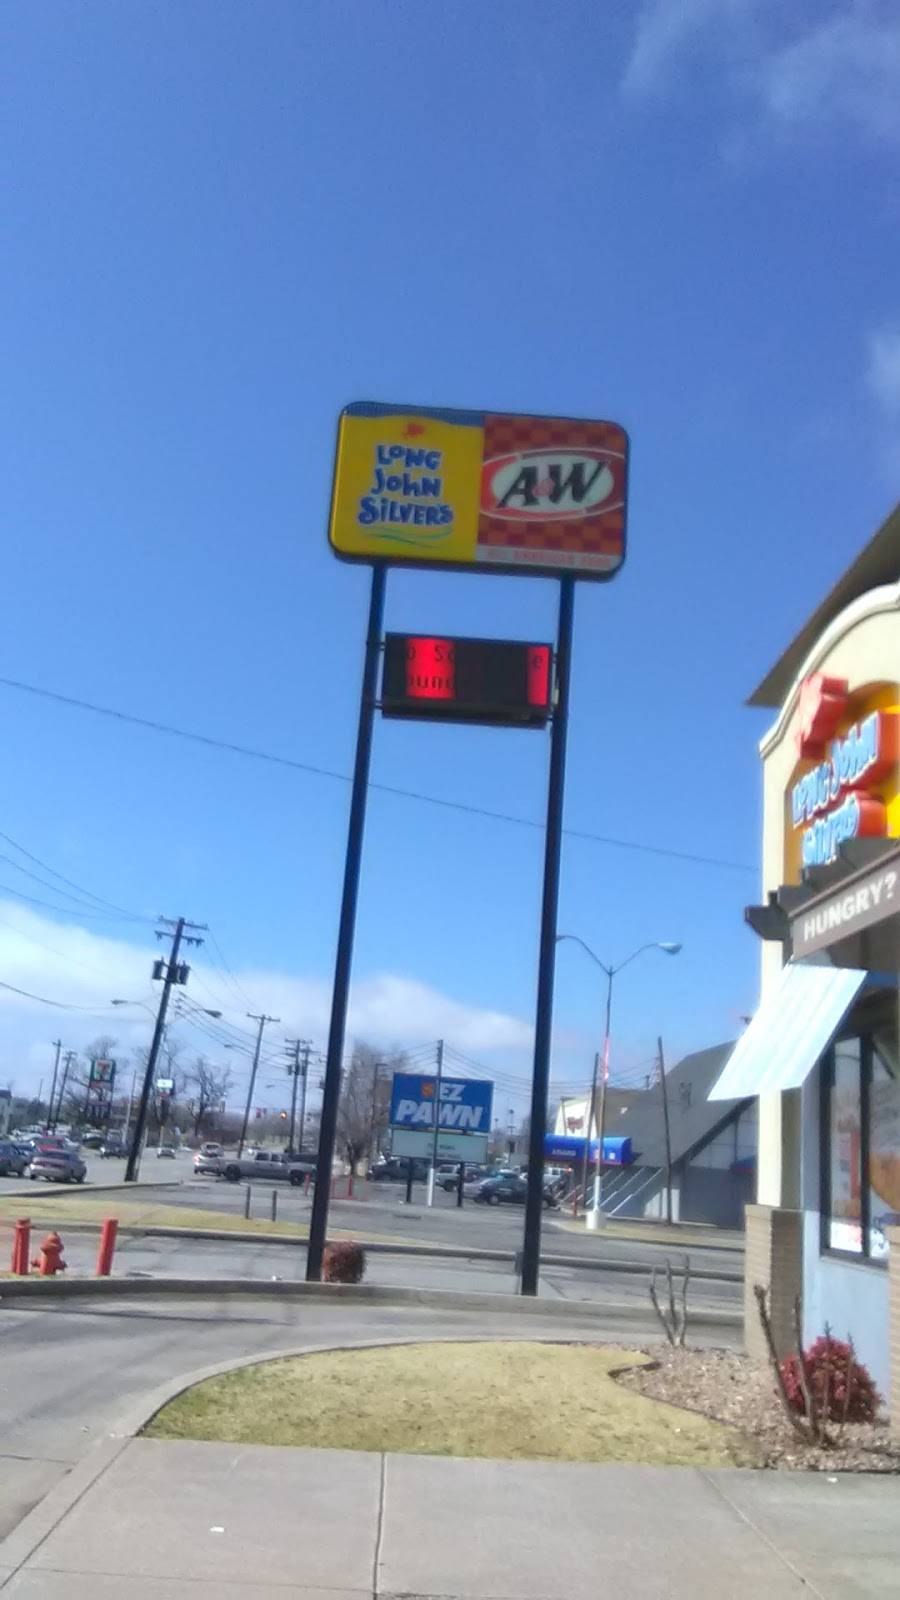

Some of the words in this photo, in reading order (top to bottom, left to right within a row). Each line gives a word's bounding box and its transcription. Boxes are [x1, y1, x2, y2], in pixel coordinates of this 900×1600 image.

[803, 872, 897, 943] HUNGRY?
[439, 1082, 466, 1101] EZ
[396, 1099, 483, 1128] PAWN
